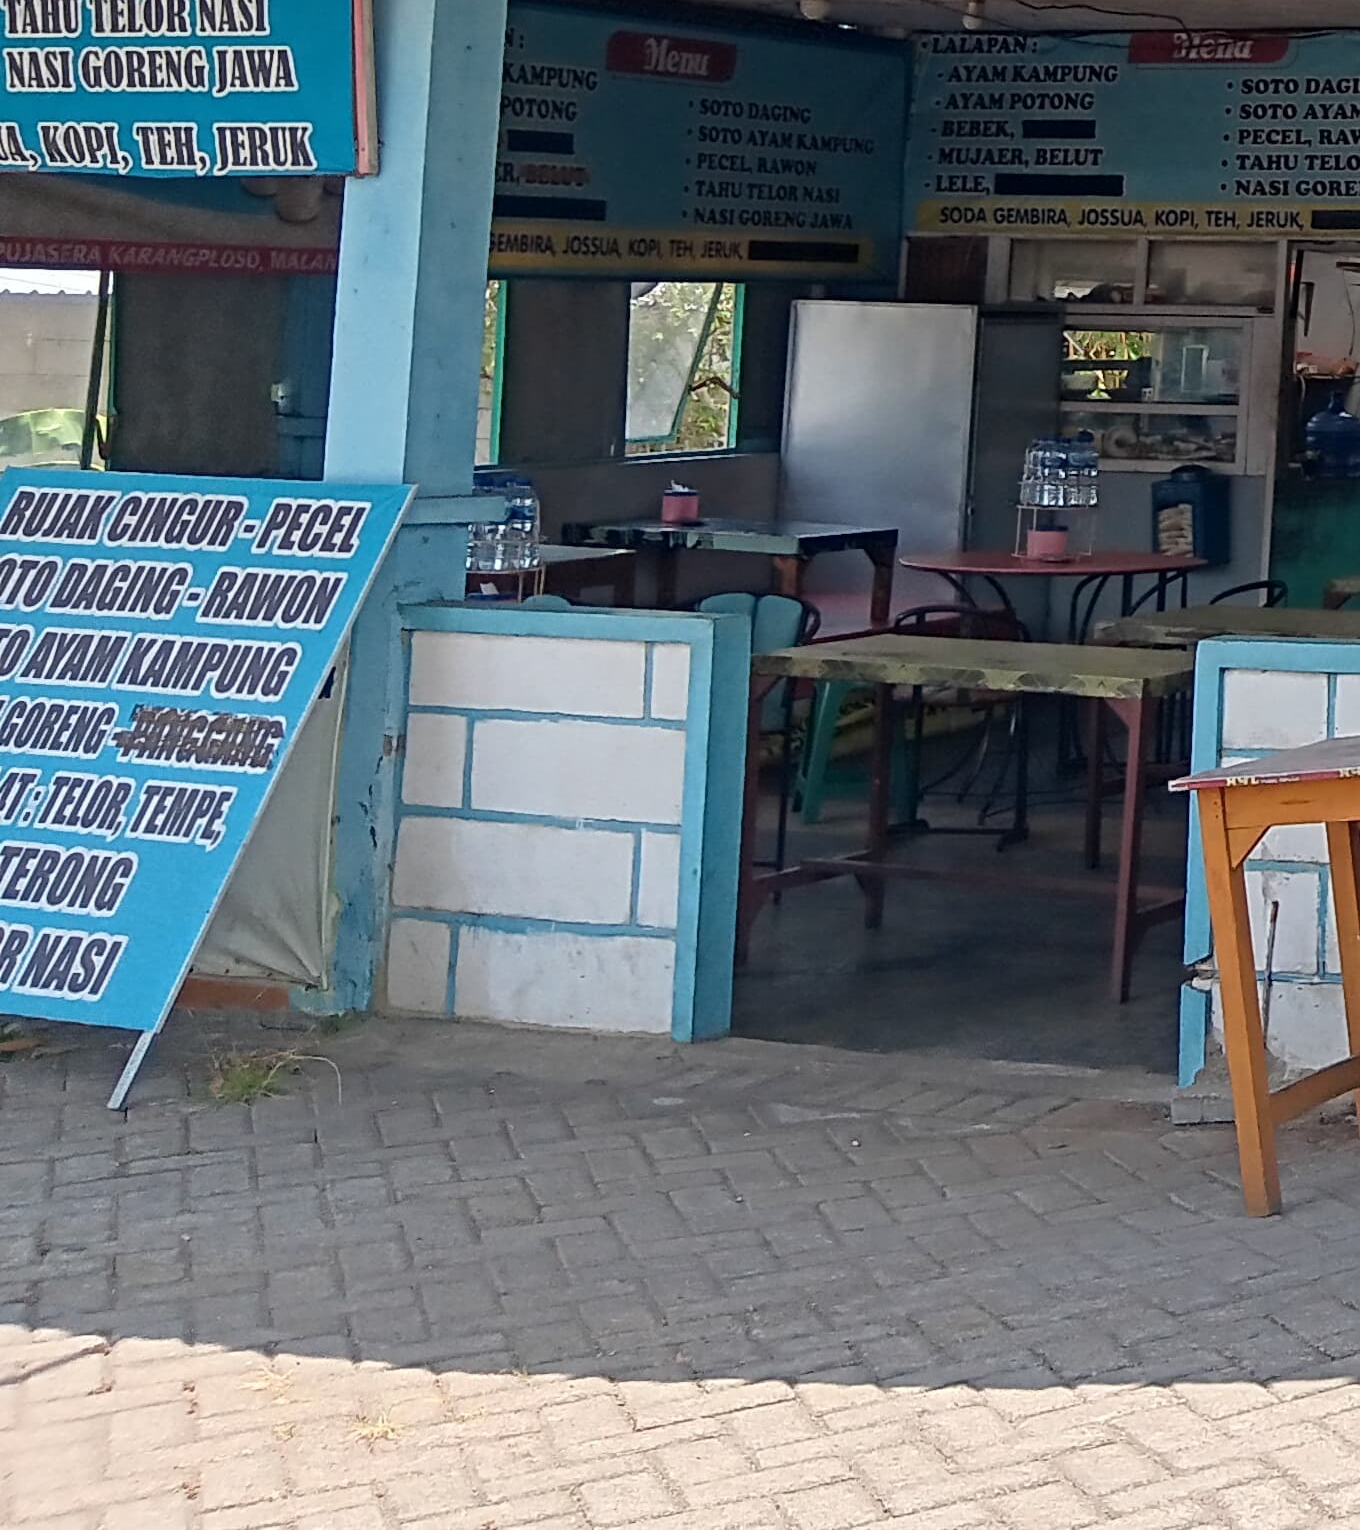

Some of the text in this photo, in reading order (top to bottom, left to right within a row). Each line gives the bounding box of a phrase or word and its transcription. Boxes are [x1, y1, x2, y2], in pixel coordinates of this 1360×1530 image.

[5, 47, 297, 95] NASI GORENG JAWA
[948, 65, 1118, 83] AYAM KAMPUNG
[1241, 77, 1300, 95] SOTO
[945, 92, 1094, 112] AYAM POTONG
[1240, 102, 1298, 121] SOTO
[41, 124, 314, 172] KOPI, TEH, JERUK
[1238, 128, 1312, 147] PECEL,
[938, 147, 1103, 168] MUJAER, BELUT
[1236, 153, 1299, 172] TAHU
[935, 174, 991, 196] LELE,
[1235, 179, 1289, 197] NASI
[939, 208, 1305, 231] SODA KOPI, TEH, JERUK,
[1, 489, 370, 555] RUJAK CINGUR PECEL
[49, 560, 346, 628] DAGING RAWON
[17, 628, 300, 700] AYAM KAMPUNG
[36, 772, 237, 852] TELOR, TEMPE,
[29, 927, 128, 1002] NASI
